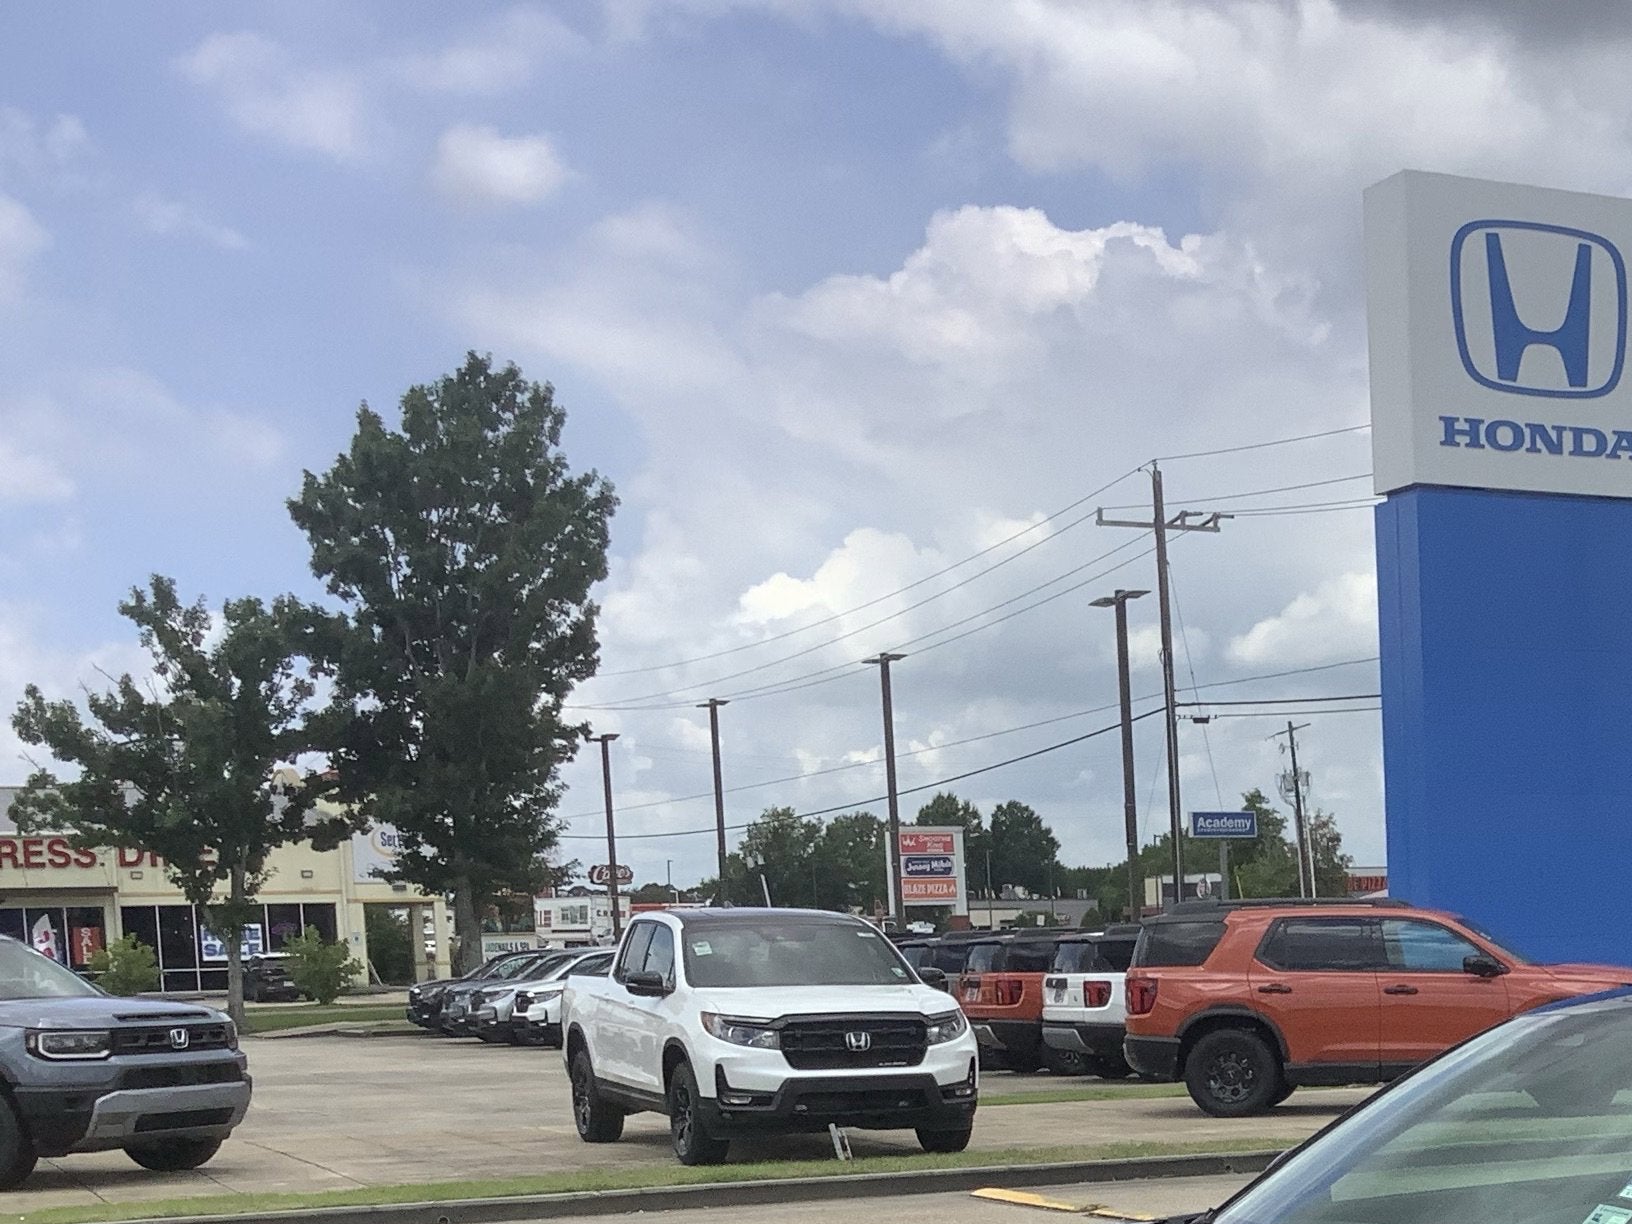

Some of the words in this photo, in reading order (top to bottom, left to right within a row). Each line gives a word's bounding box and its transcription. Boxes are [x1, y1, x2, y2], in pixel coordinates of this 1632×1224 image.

[1197, 816, 1251, 830] Academy
[928, 883, 949, 894] PIZZA
[204, 943, 260, 956] SAE
